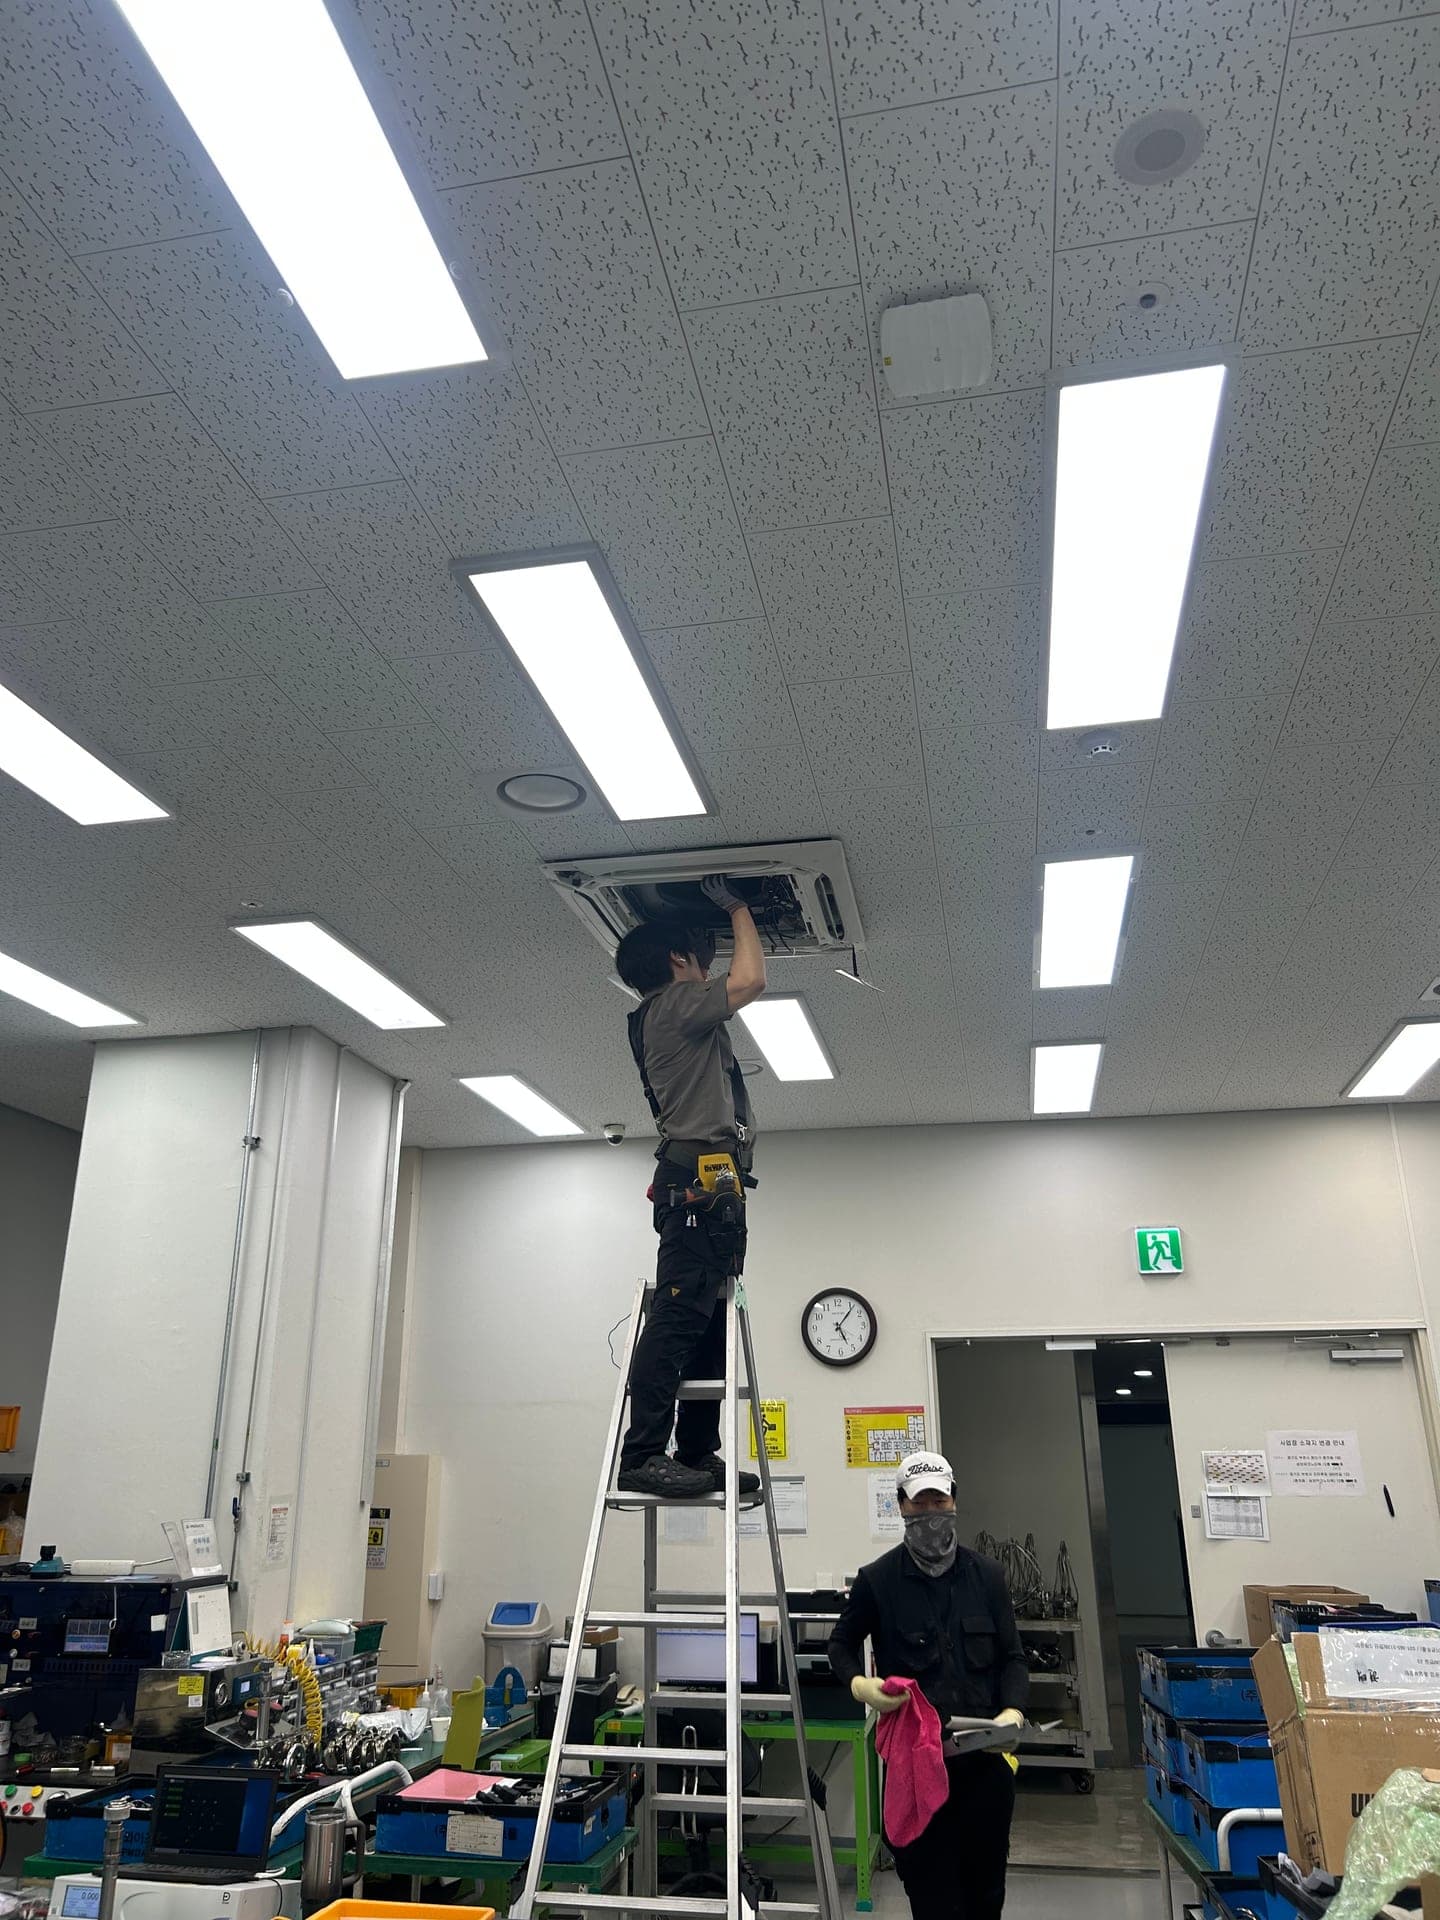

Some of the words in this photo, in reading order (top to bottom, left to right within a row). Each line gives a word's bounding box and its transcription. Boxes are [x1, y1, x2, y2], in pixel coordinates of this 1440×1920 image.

[833, 1299, 842, 1307] 12
[823, 1304, 830, 1312] 11
[815, 1313, 823, 1321] 10
[857, 1309, 862, 1318] 2
[812, 1324, 818, 1332] 9
[861, 1321, 866, 1330] 3
[816, 1337, 823, 1345] 8
[857, 1334, 863, 1342] 4
[838, 1348, 844, 1356] 6
[851, 1344, 856, 1352] 5
[1280, 1439, 1297, 1447] 사업장
[1300, 1439, 1317, 1447] 소재지
[1318, 1439, 1331, 1447] 변경
[1333, 1439, 1345, 1447] 안내
[905, 1463, 944, 1478] Titleist
